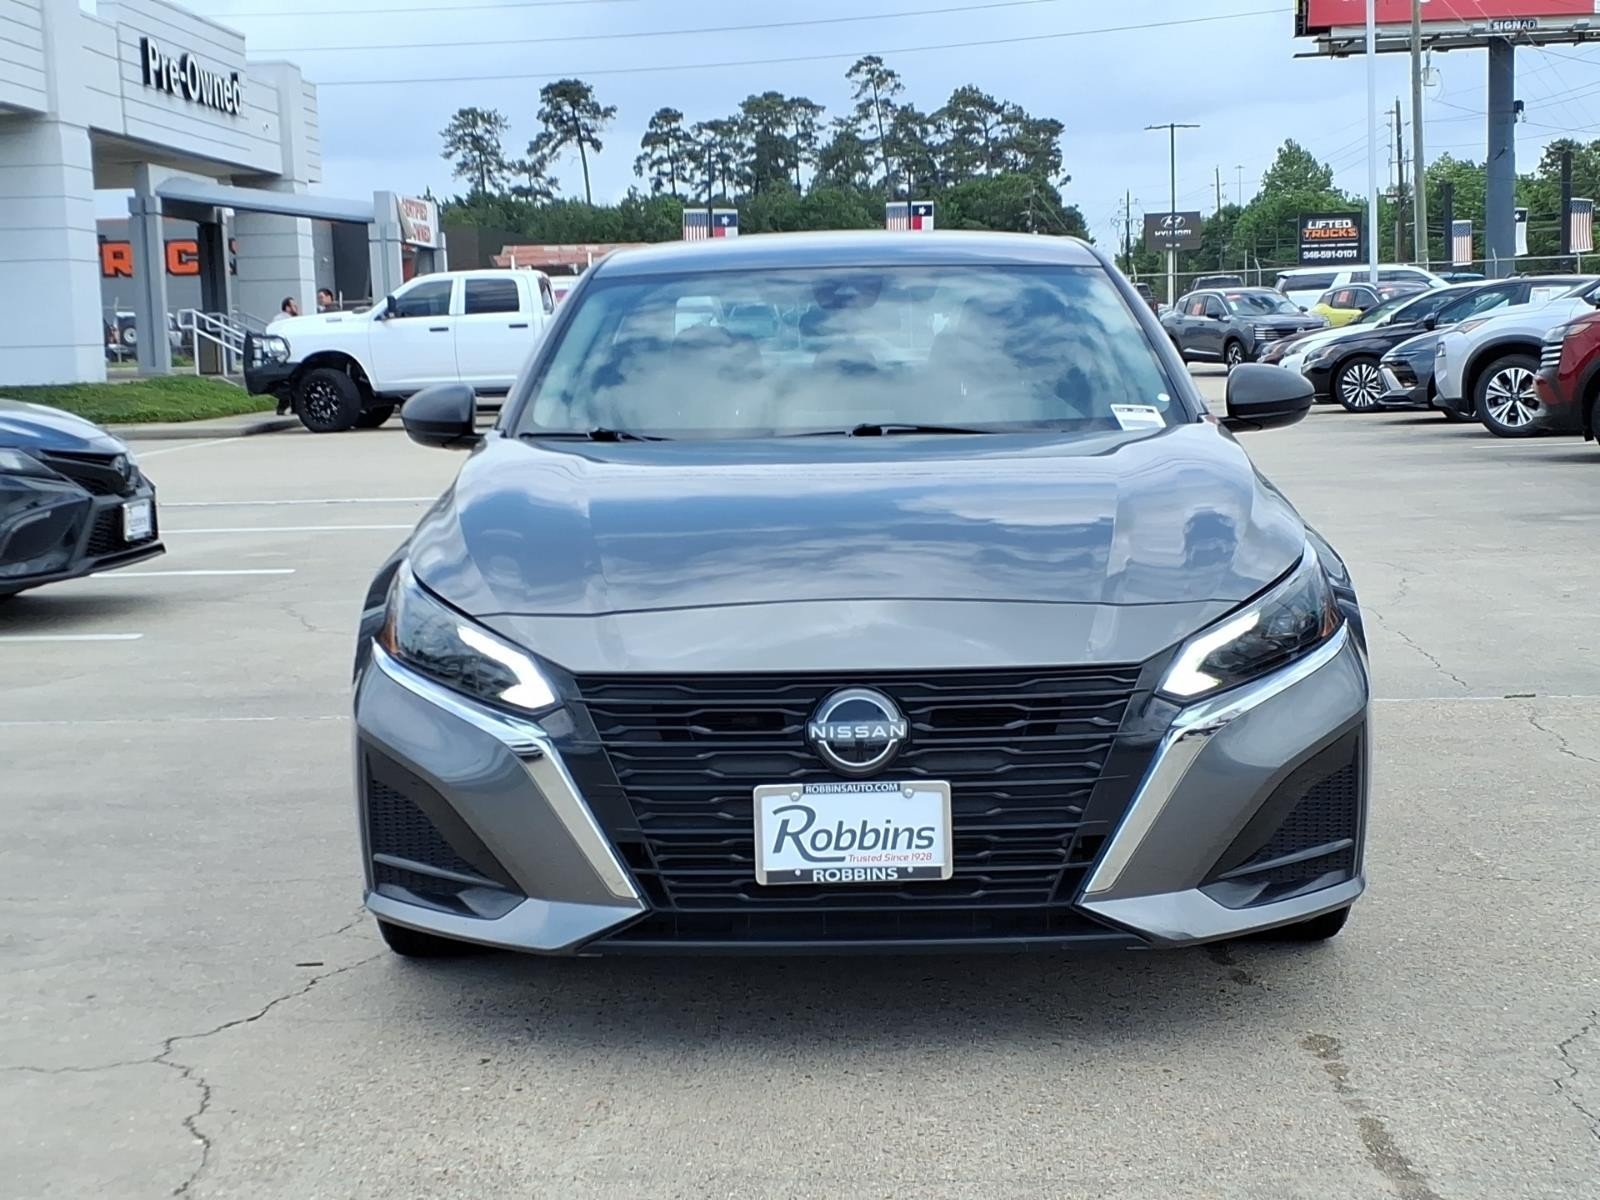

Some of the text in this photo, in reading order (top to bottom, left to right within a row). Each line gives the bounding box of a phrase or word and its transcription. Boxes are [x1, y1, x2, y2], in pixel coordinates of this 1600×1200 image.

[1492, 20, 1537, 30] SIGNAD
[140, 36, 241, 116] Pre-Owned
[1307, 219, 1352, 229] LIFTED
[1304, 228, 1357, 238] TRUCKS
[811, 724, 905, 739] NISSAN
[805, 783, 898, 794] ROBBINSAUTO.COM
[772, 804, 936, 863] Robbins
[849, 852, 932, 863] Trusted Since 1928
[812, 867, 898, 883] ROBBINS
